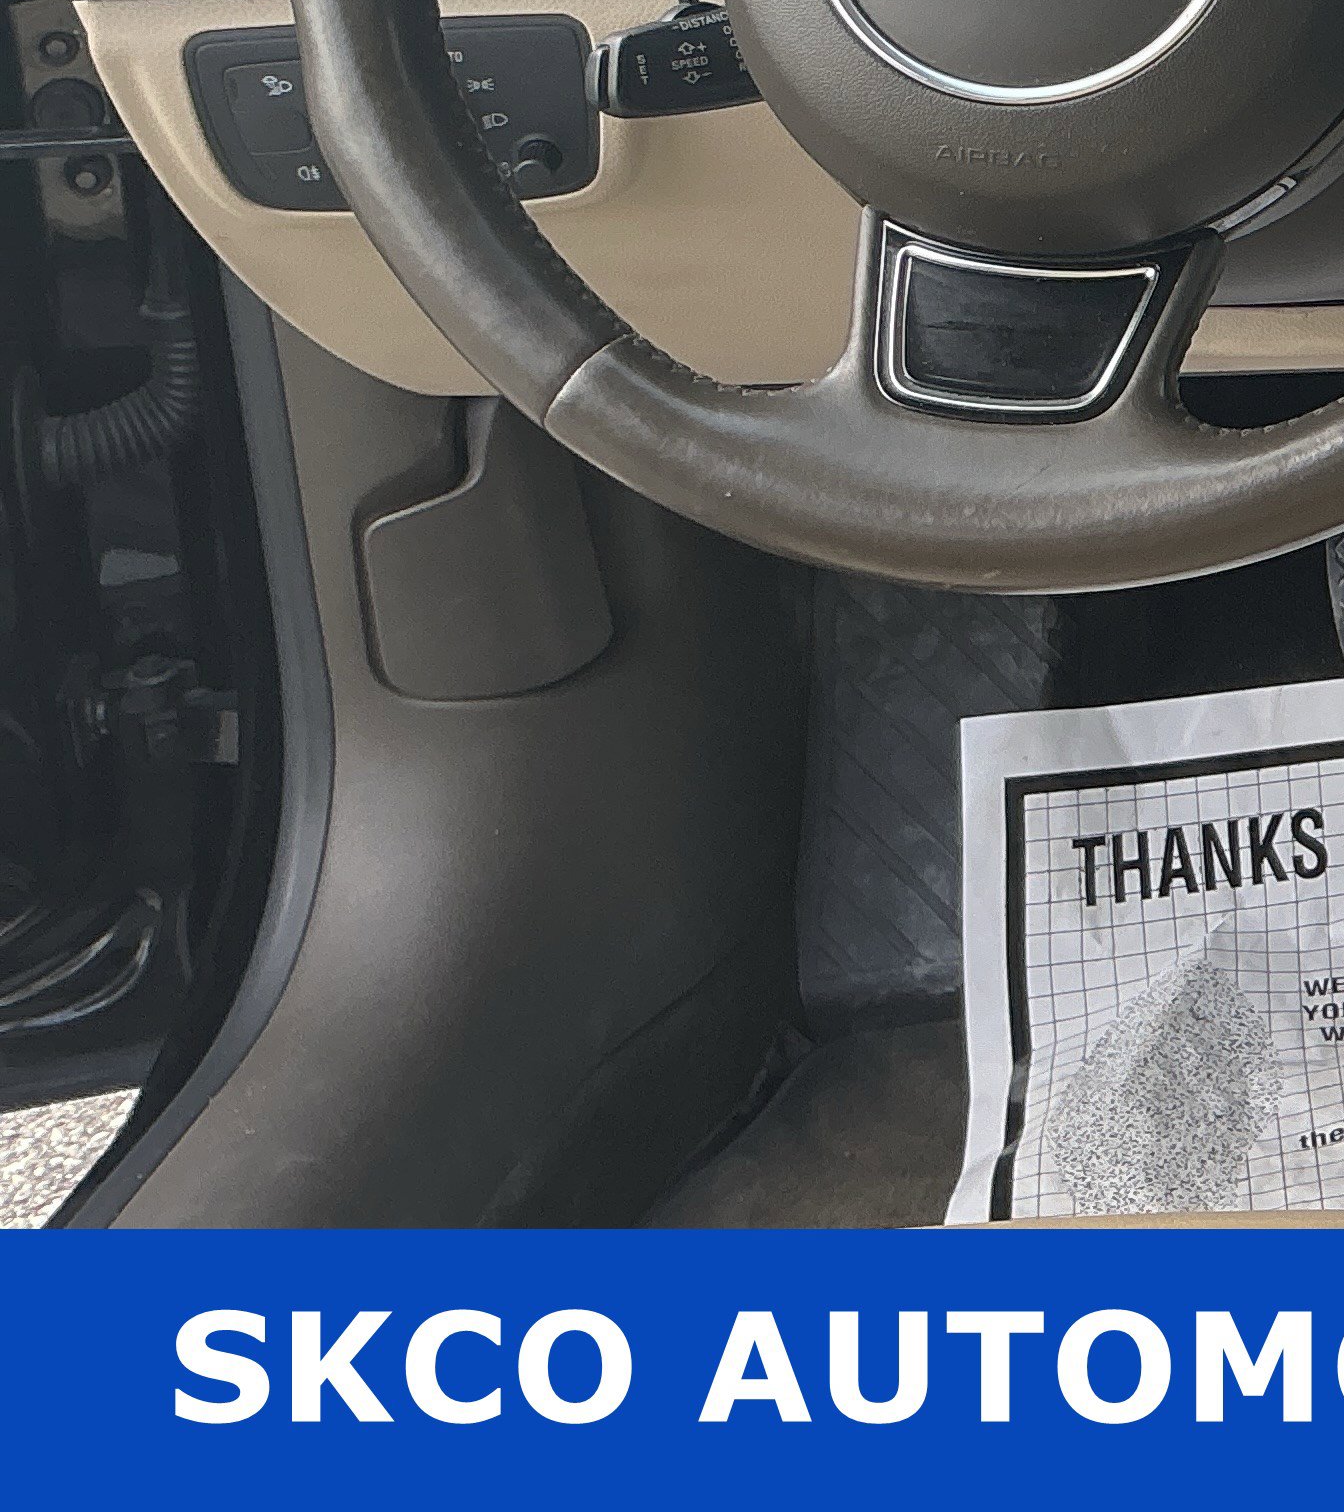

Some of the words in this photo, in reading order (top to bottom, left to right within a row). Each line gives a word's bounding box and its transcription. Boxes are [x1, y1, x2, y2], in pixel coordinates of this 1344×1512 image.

[679, 11, 730, 31] DISTANC
[671, 56, 709, 71] SPEED
[1072, 807, 1328, 907] THANKS
[1299, 1126, 1344, 1150] the
